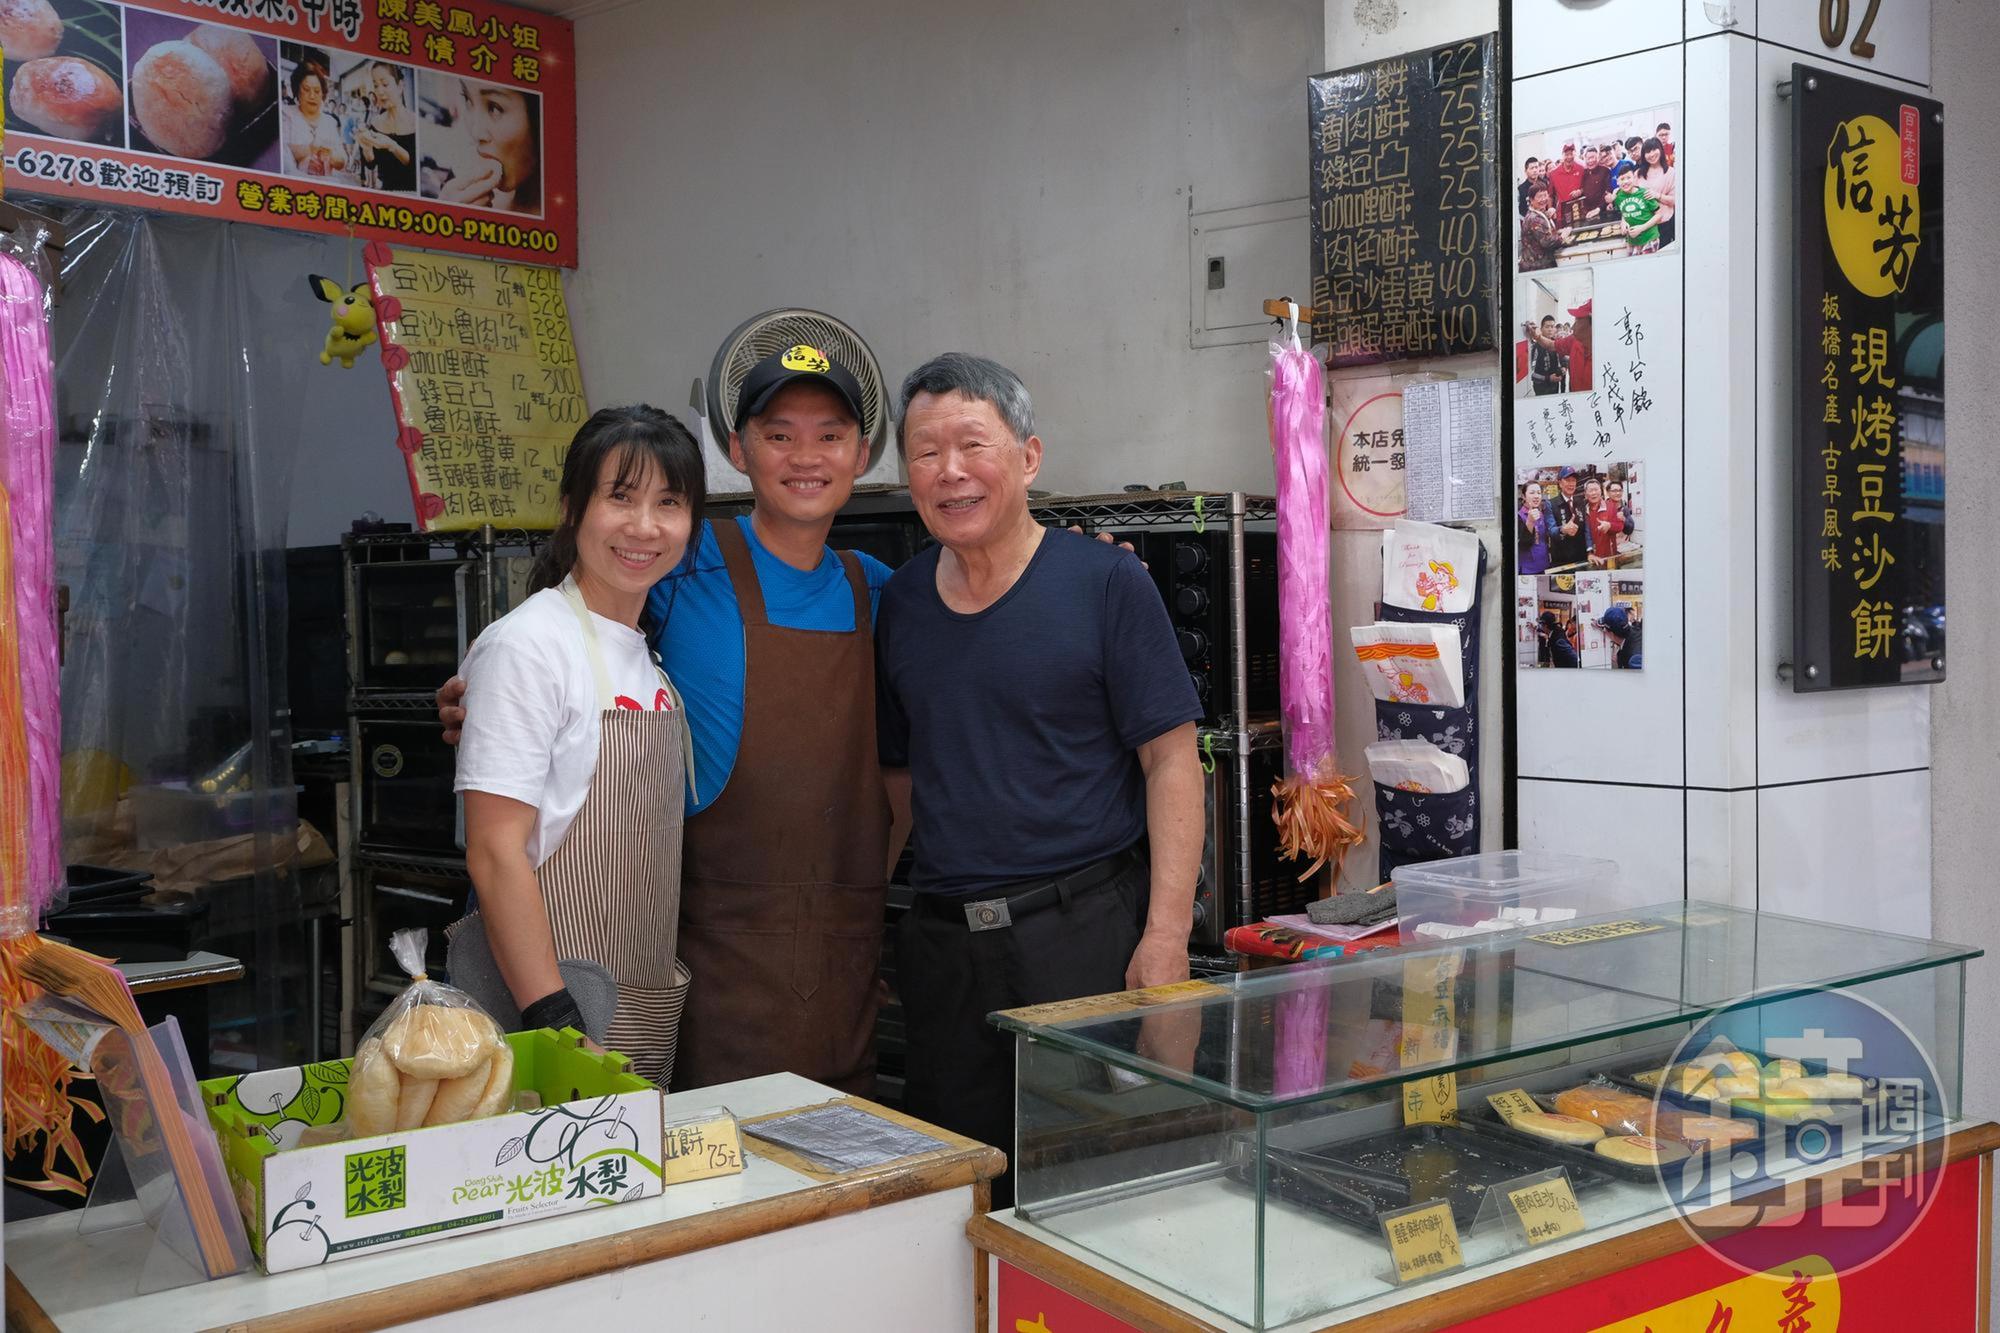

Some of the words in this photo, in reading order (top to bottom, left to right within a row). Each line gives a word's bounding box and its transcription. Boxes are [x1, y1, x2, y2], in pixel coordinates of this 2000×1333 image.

[378, 0, 541, 51] 陳美鳳小姐
[380, 24, 540, 82] 熱情介紹
[1440, 84, 1478, 126] 25
[1321, 140, 1410, 191] 綠豆凸
[1439, 126, 1480, 167] 25
[1439, 166, 1480, 210] 25
[1831, 124, 1919, 291] 信芳
[1439, 212, 1477, 256] 40
[392, 263, 475, 298] 豆沙餅
[495, 264, 511, 285] 12
[525, 268, 560, 293] 264
[1440, 257, 1476, 299] 40
[496, 288, 512, 308] 24
[529, 293, 566, 319] 528
[533, 318, 568, 342] 282
[1442, 304, 1478, 345] 40
[539, 342, 574, 366] 564
[1821, 292, 1842, 424] 板橋名產
[417, 378, 494, 409] 綠豆凸
[512, 375, 528, 391] 12
[424, 405, 501, 434] 魯肉酥
[515, 404, 532, 423] 24
[547, 397, 582, 424] 600
[524, 448, 541, 468] 12
[528, 484, 547, 505] 15
[1821, 441, 1842, 571] 古早風味
[1850, 327, 1896, 660] 現烤豆沙餅
[347, 1147, 405, 1182] 光波
[350, 1177, 405, 1212] 水梨
[452, 1181, 506, 1205] Pear
[508, 1204, 529, 1215] Fruits
[530, 1199, 559, 1210] Selector
